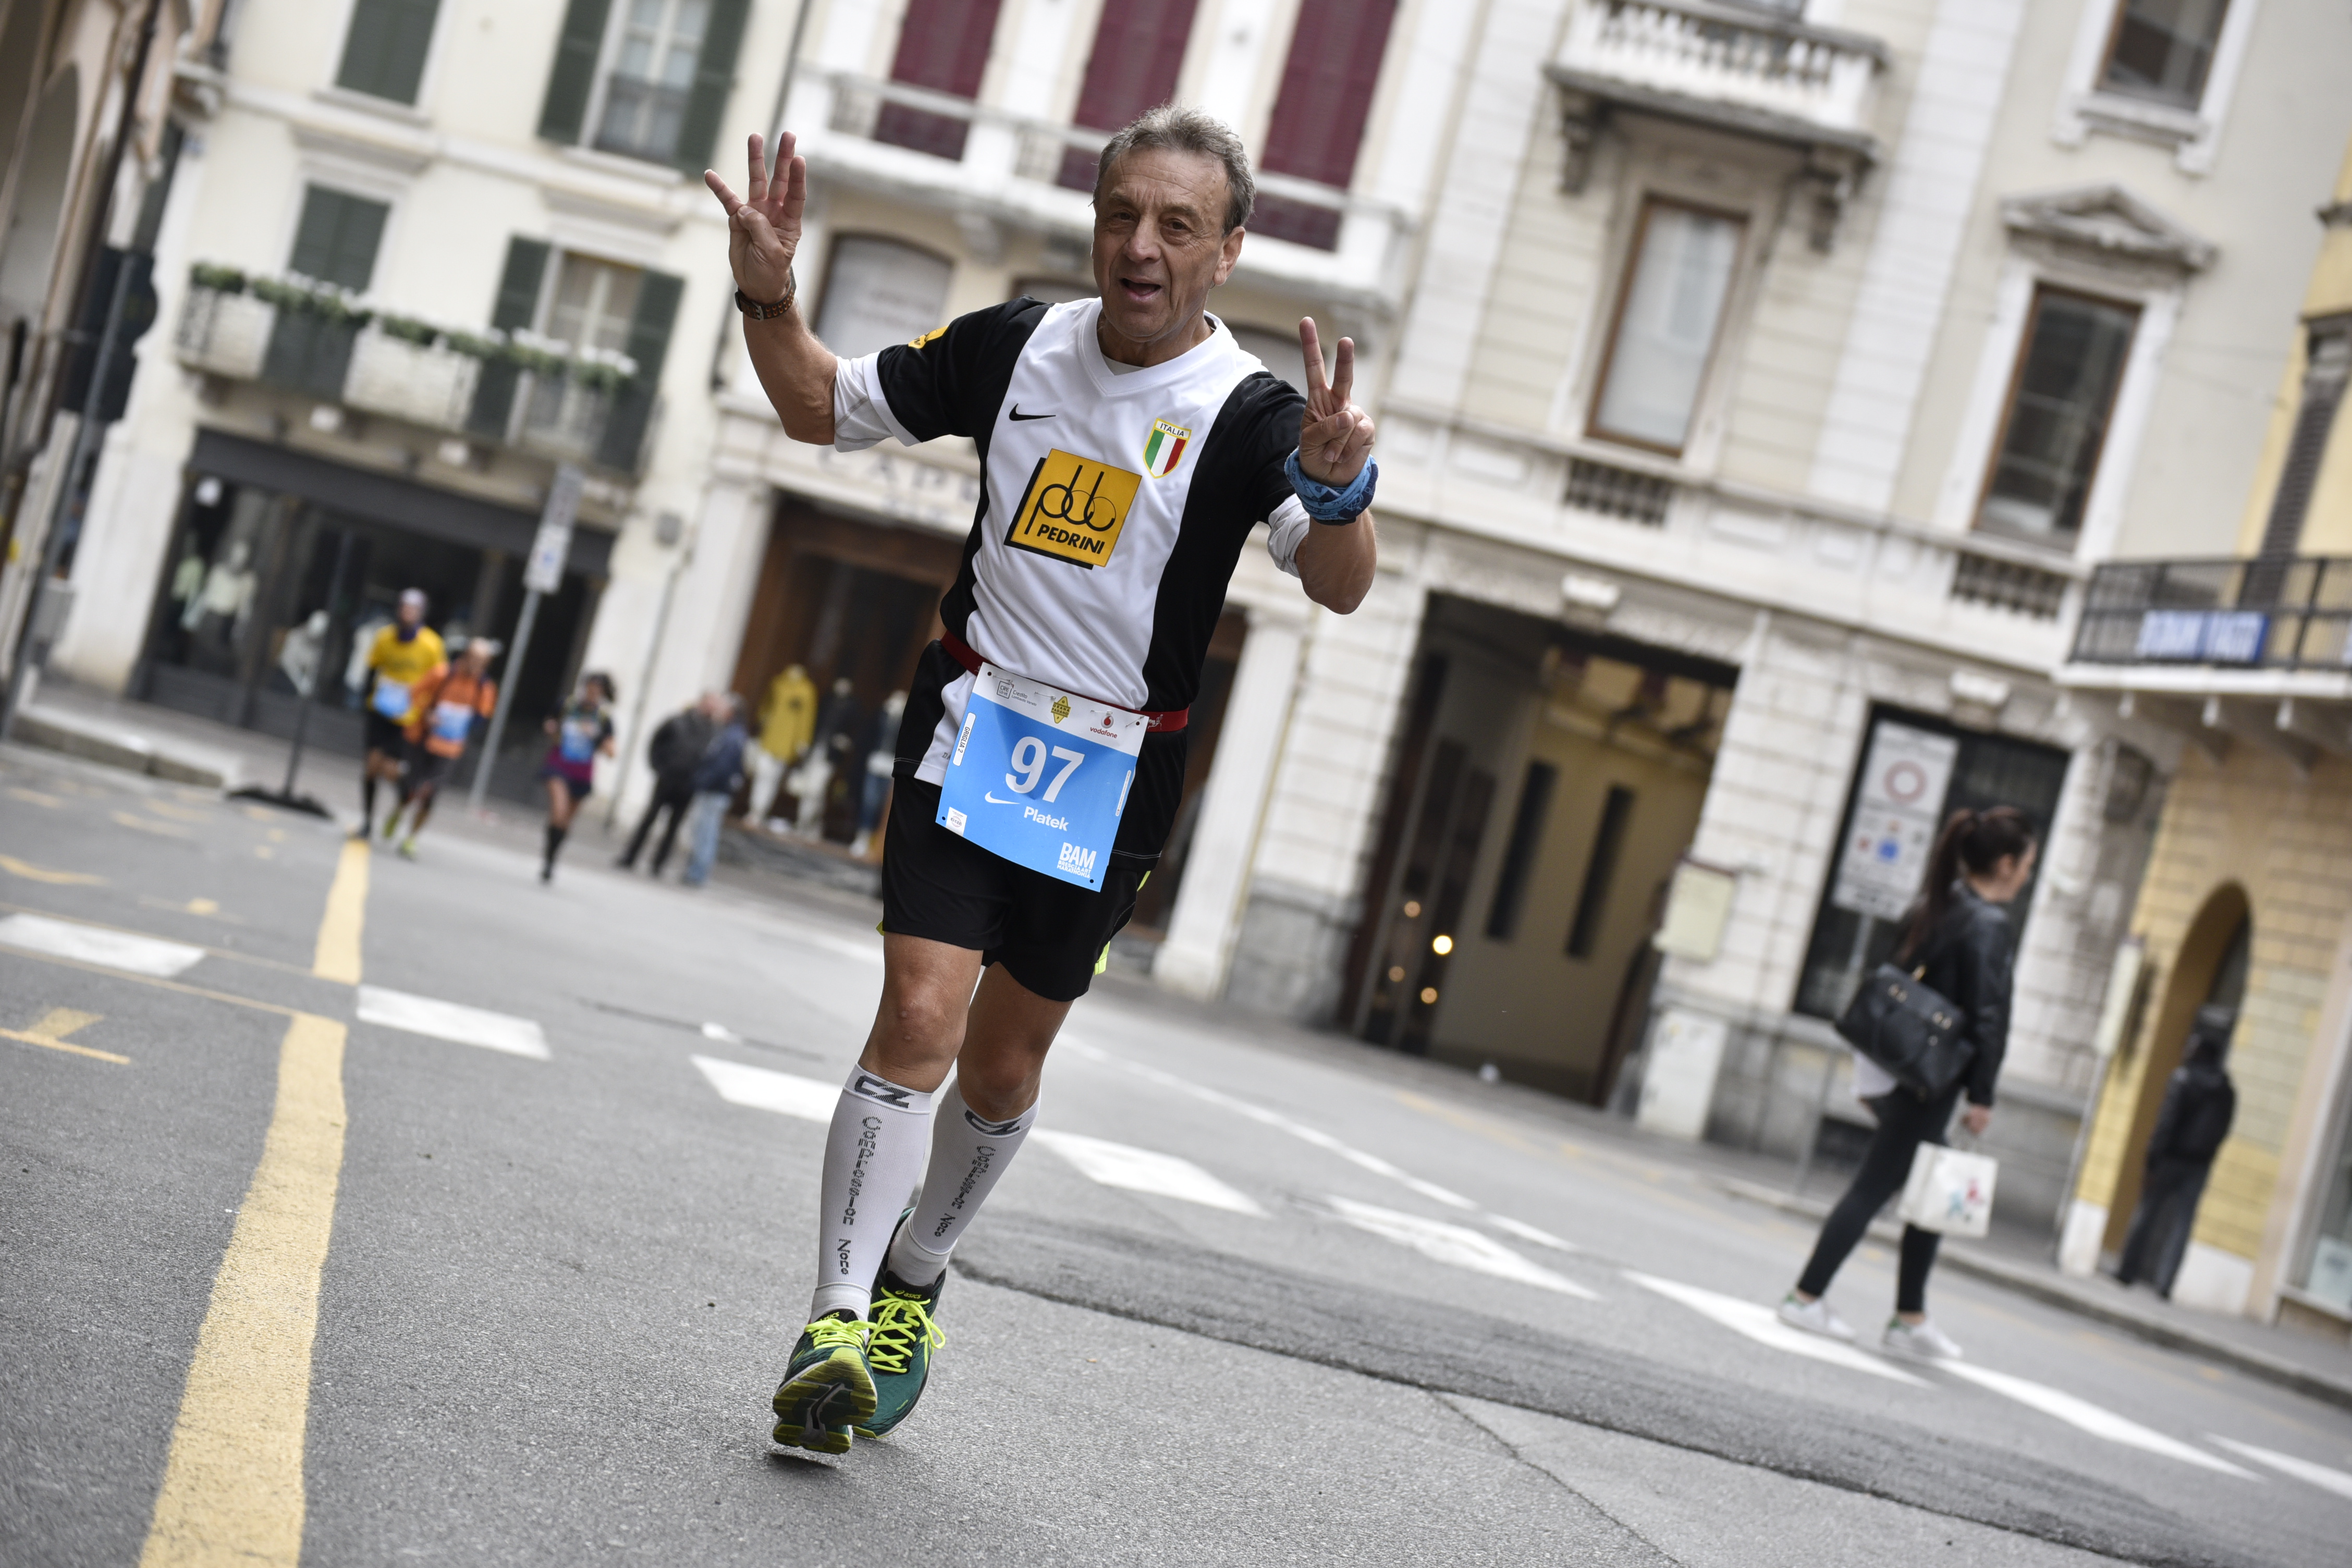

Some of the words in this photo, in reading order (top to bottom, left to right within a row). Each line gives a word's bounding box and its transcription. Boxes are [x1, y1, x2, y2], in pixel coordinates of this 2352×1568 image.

[1159, 423, 1185, 437] ITALIA
[1037, 524, 1106, 555] PEDRINI
[1013, 690, 1028, 699] Credito
[1051, 707, 1069, 716] PADANO
[1052, 704, 1070, 713] GRANA
[959, 726, 971, 748] GRIGLIA
[1090, 727, 1118, 739] vodafone
[1005, 736, 1085, 803] 97
[1023, 806, 1069, 831] Platek
[1058, 860, 1081, 871] BRESCIA
[1059, 842, 1097, 869] BAM
[842, 1116, 883, 1226] Compression
[951, 1145, 996, 1210] Compression
